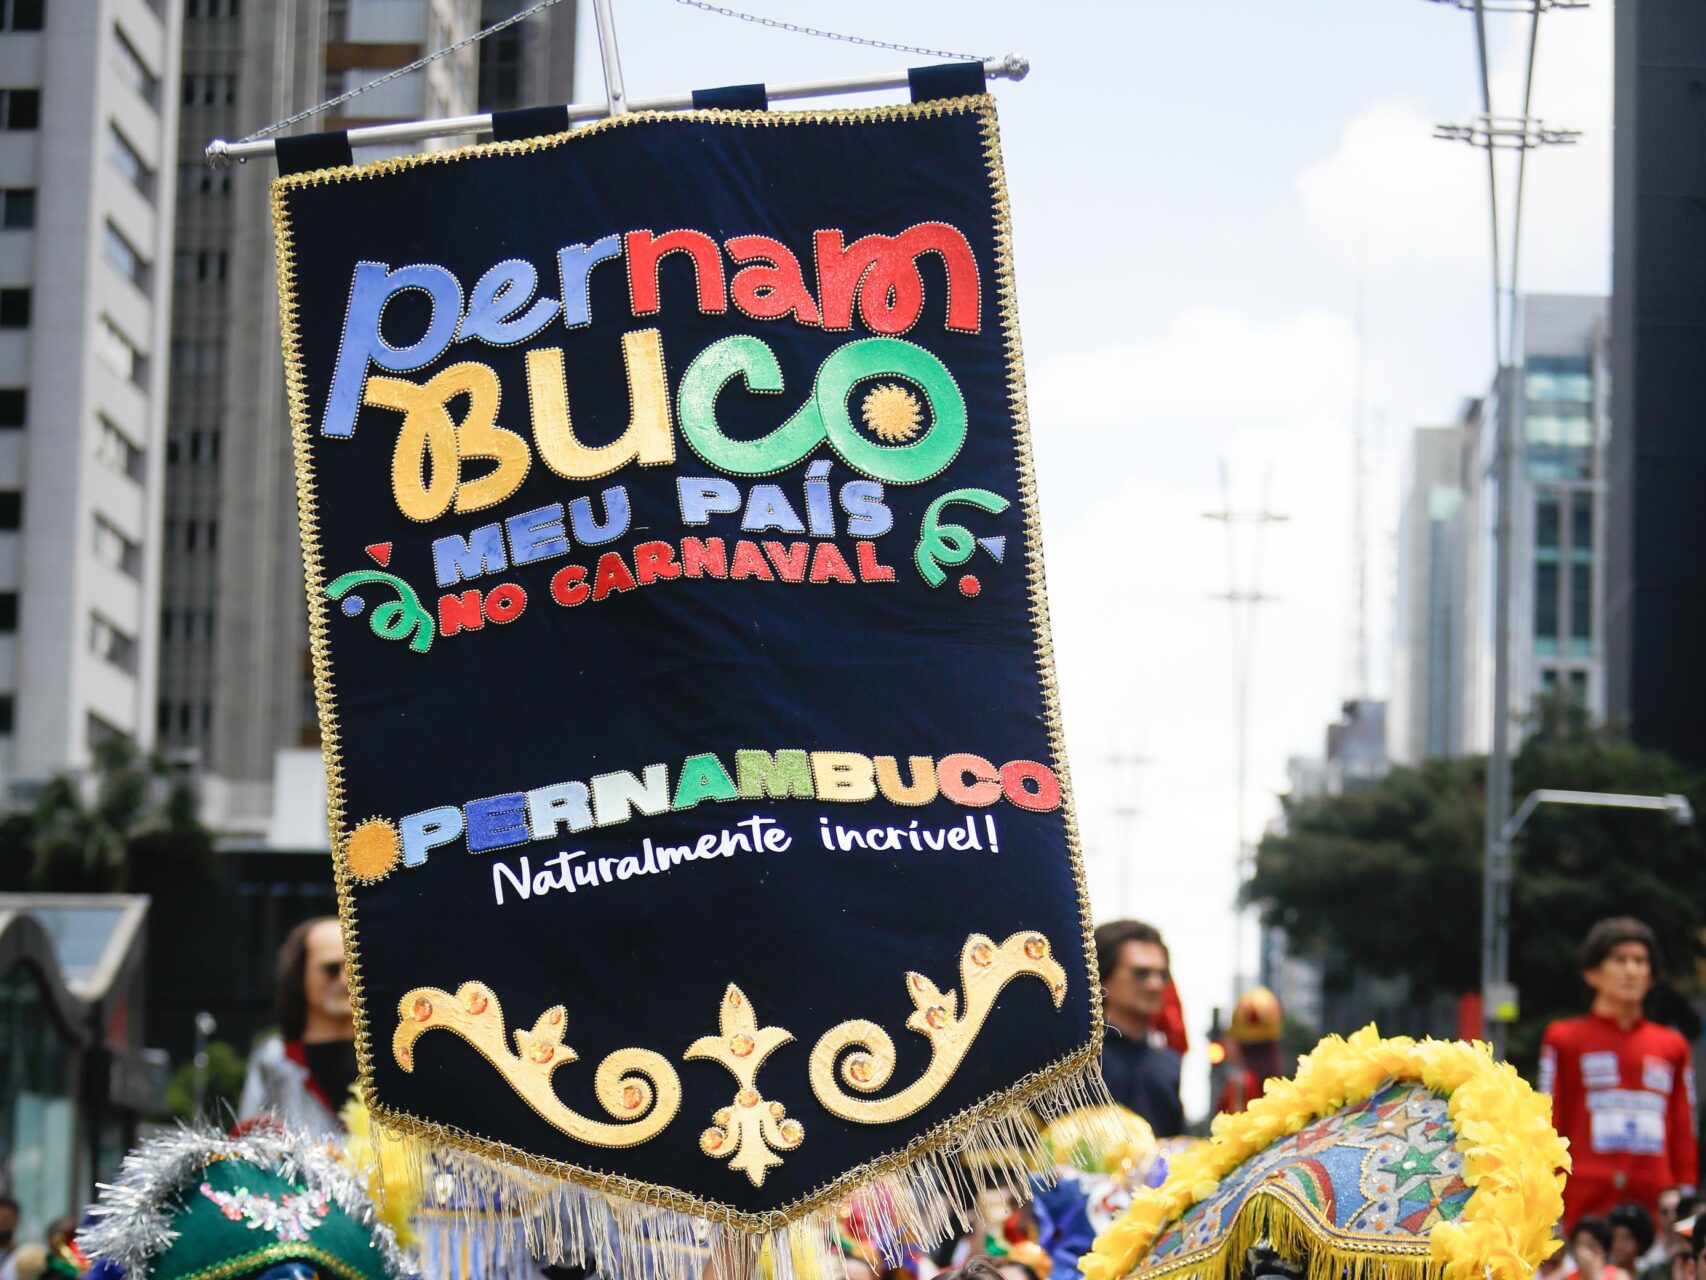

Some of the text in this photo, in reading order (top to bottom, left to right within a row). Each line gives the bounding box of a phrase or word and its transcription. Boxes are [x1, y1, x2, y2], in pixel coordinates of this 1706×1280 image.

[433, 459, 894, 588] MEU PAÍS
[439, 536, 898, 636] NO CARNAVAL
[400, 748, 1063, 868] PERNAMBUCO
[493, 814, 999, 904] Naturalmente incrível!
